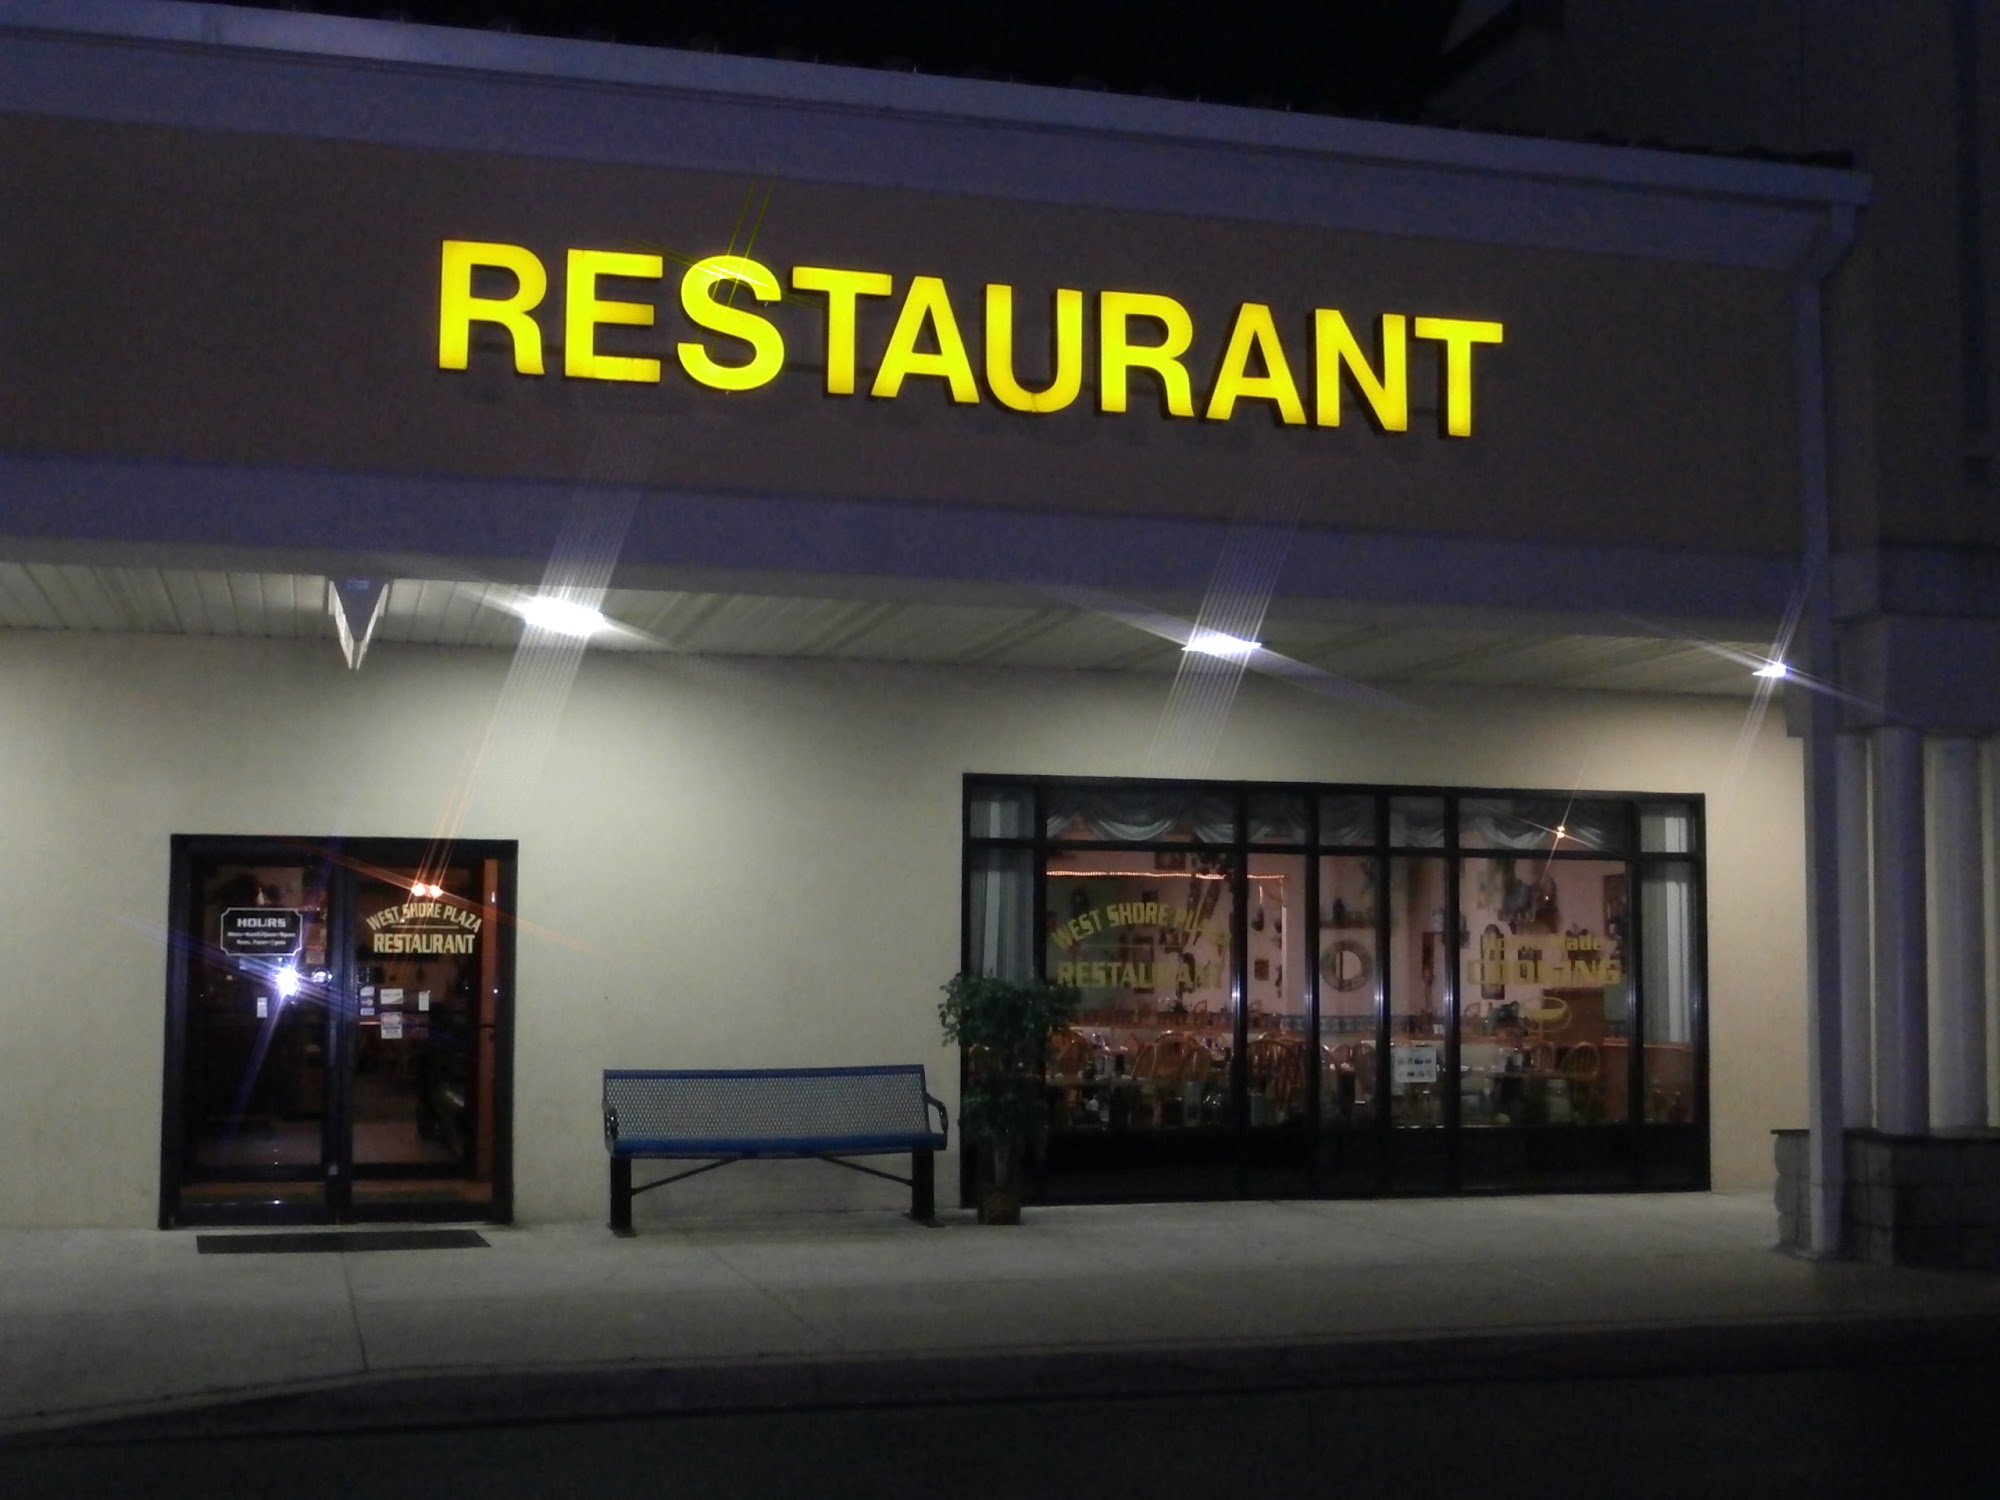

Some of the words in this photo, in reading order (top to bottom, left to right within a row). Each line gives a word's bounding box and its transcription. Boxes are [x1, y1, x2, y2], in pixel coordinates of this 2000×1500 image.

[438, 240, 1503, 438] RESTAURANT
[236, 917, 287, 928] HOURS
[366, 907, 401, 931] WEST
[402, 902, 441, 919] SHORE
[442, 907, 482, 934] PLAZA
[1051, 908, 1103, 949] WEST
[1107, 902, 1168, 926] SHORE
[373, 933, 475, 954] RESTAURANT
